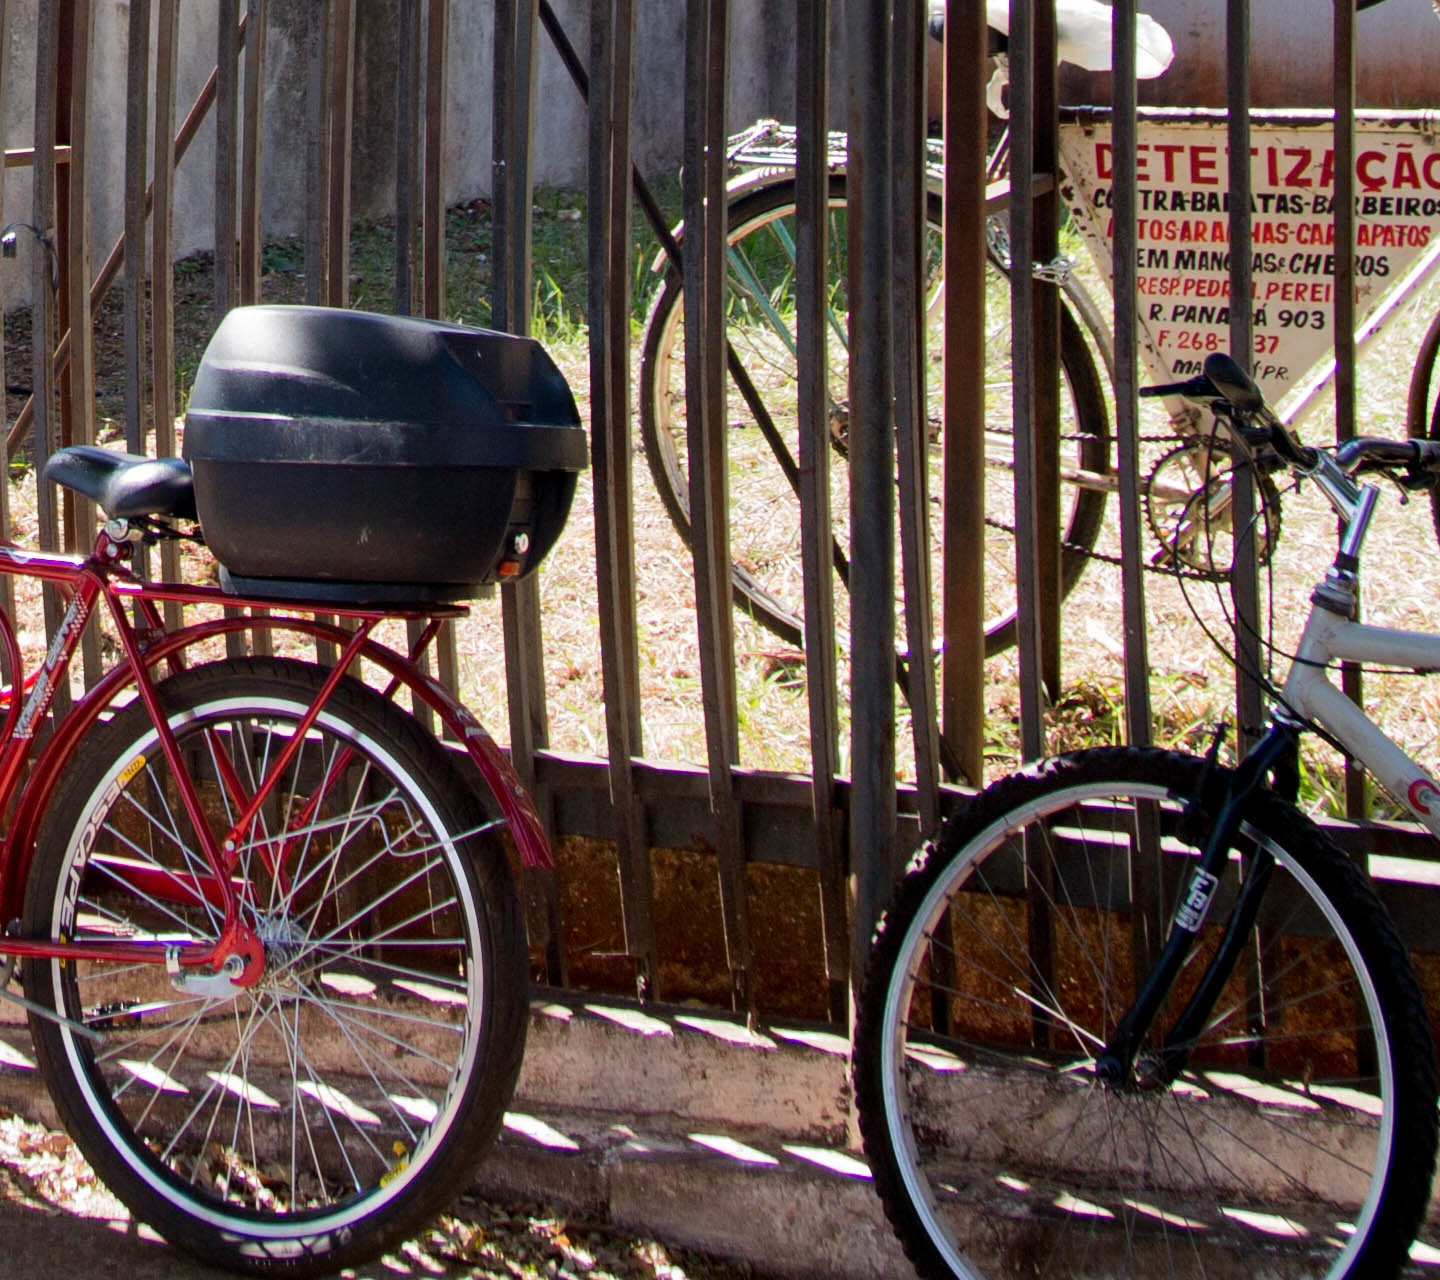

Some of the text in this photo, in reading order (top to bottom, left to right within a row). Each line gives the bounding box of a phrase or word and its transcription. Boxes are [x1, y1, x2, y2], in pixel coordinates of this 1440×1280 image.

[1182, 277, 1232, 298] PEDR
[1148, 303, 1325, 330] R. PANAÁ 903
[1157, 329, 1172, 348] F.
[61, 779, 123, 937] ESCAPE
